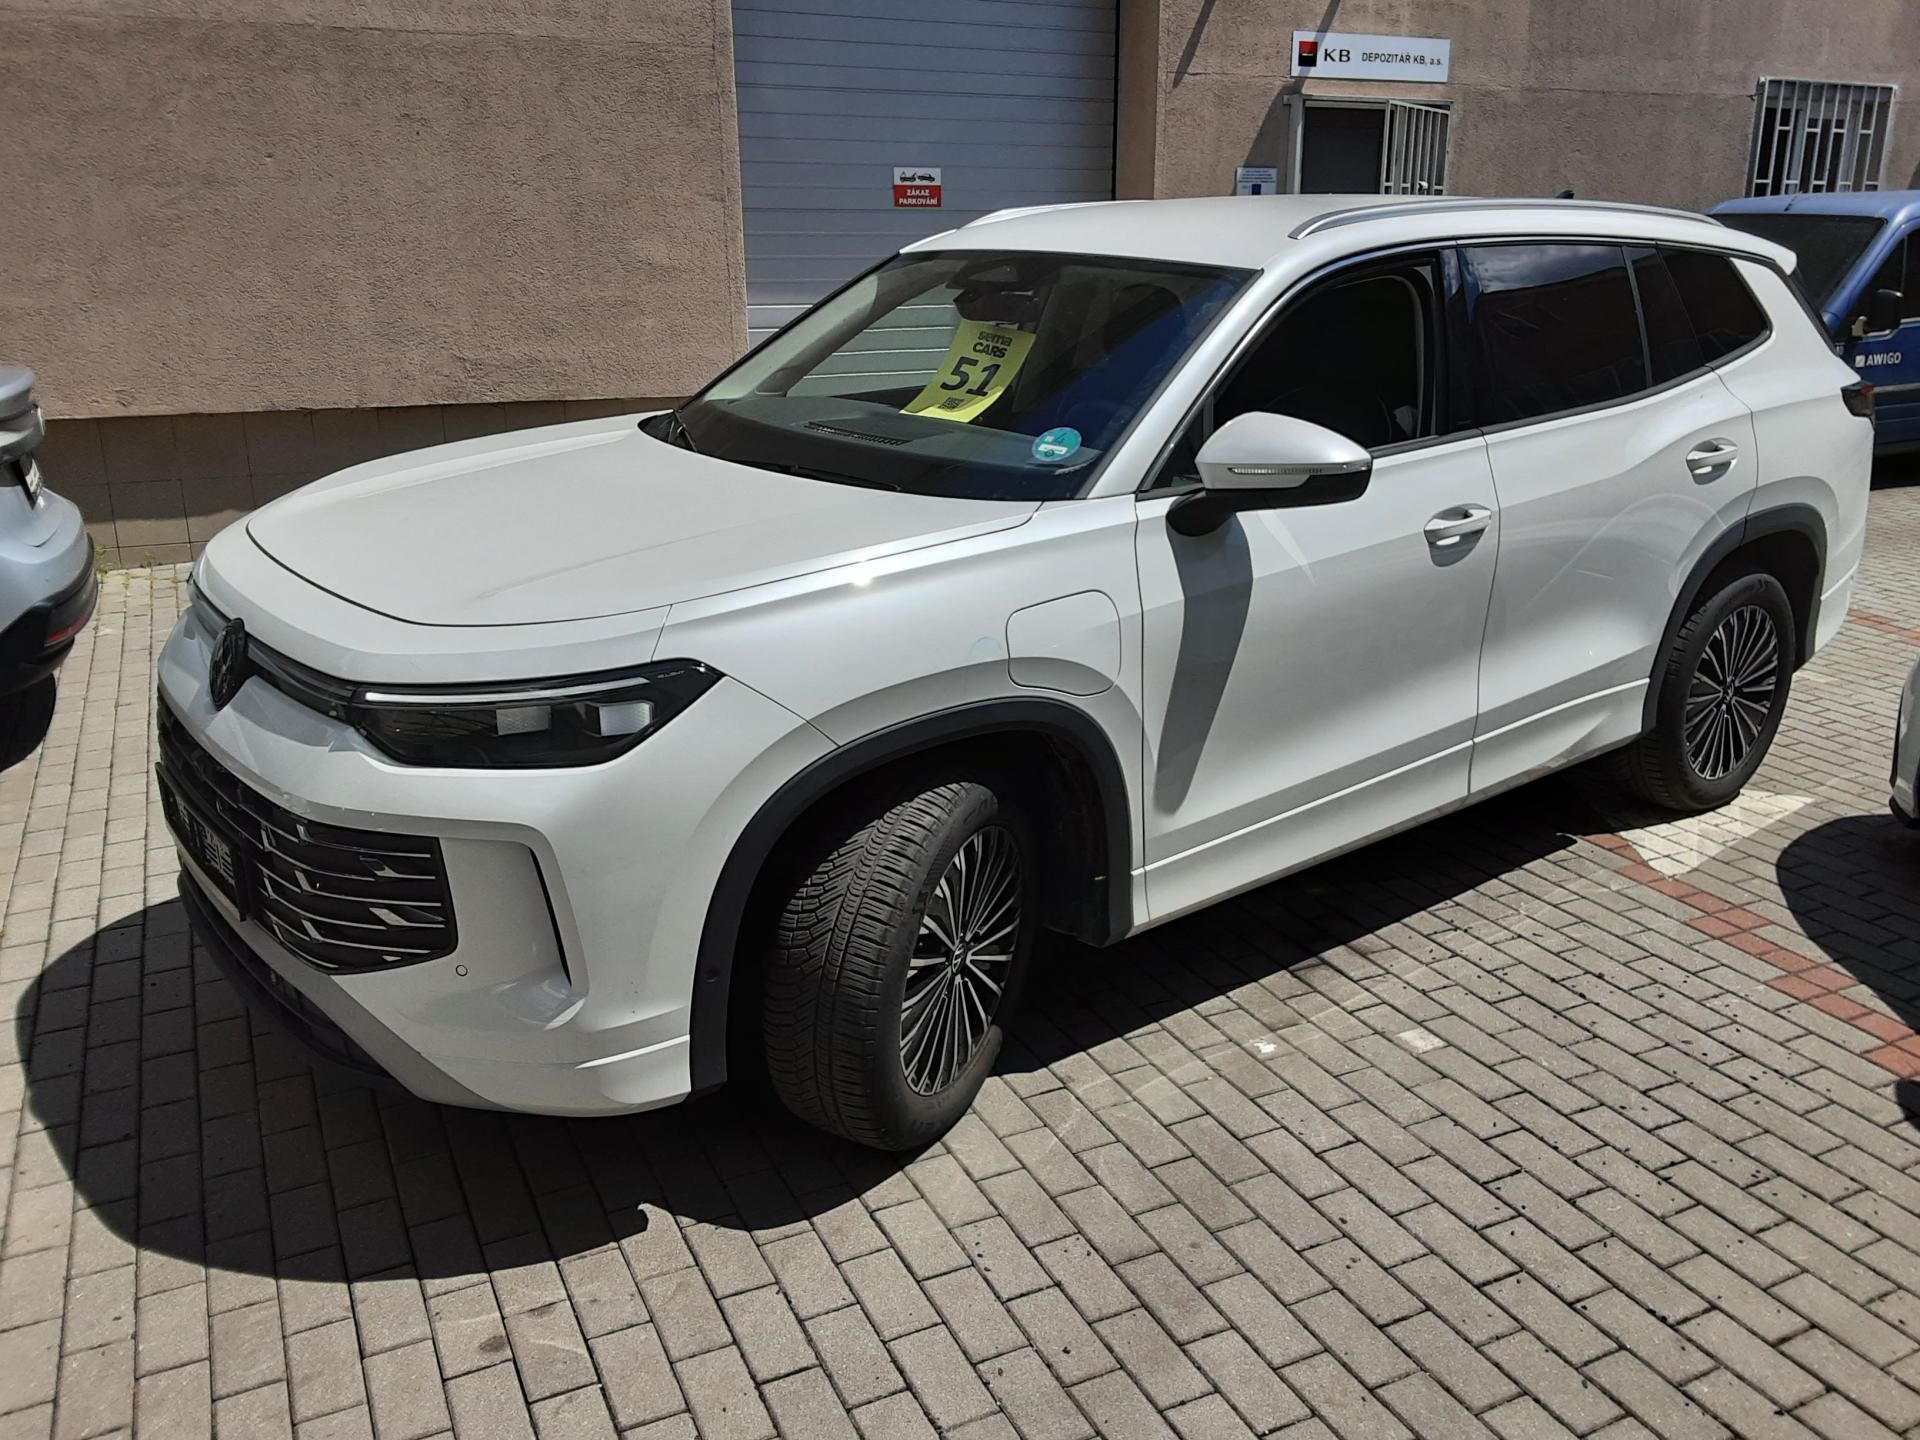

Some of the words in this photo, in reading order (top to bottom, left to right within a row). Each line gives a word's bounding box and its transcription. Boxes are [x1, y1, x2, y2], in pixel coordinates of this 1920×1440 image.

[1324, 48, 1351, 63] KB
[906, 188, 930, 196] ZÁKAZ
[899, 196, 938, 205] PARKOVÁNÍ
[972, 342, 1008, 358] CARS
[1866, 352, 1902, 366] AWIGO
[939, 356, 1001, 397] 51
